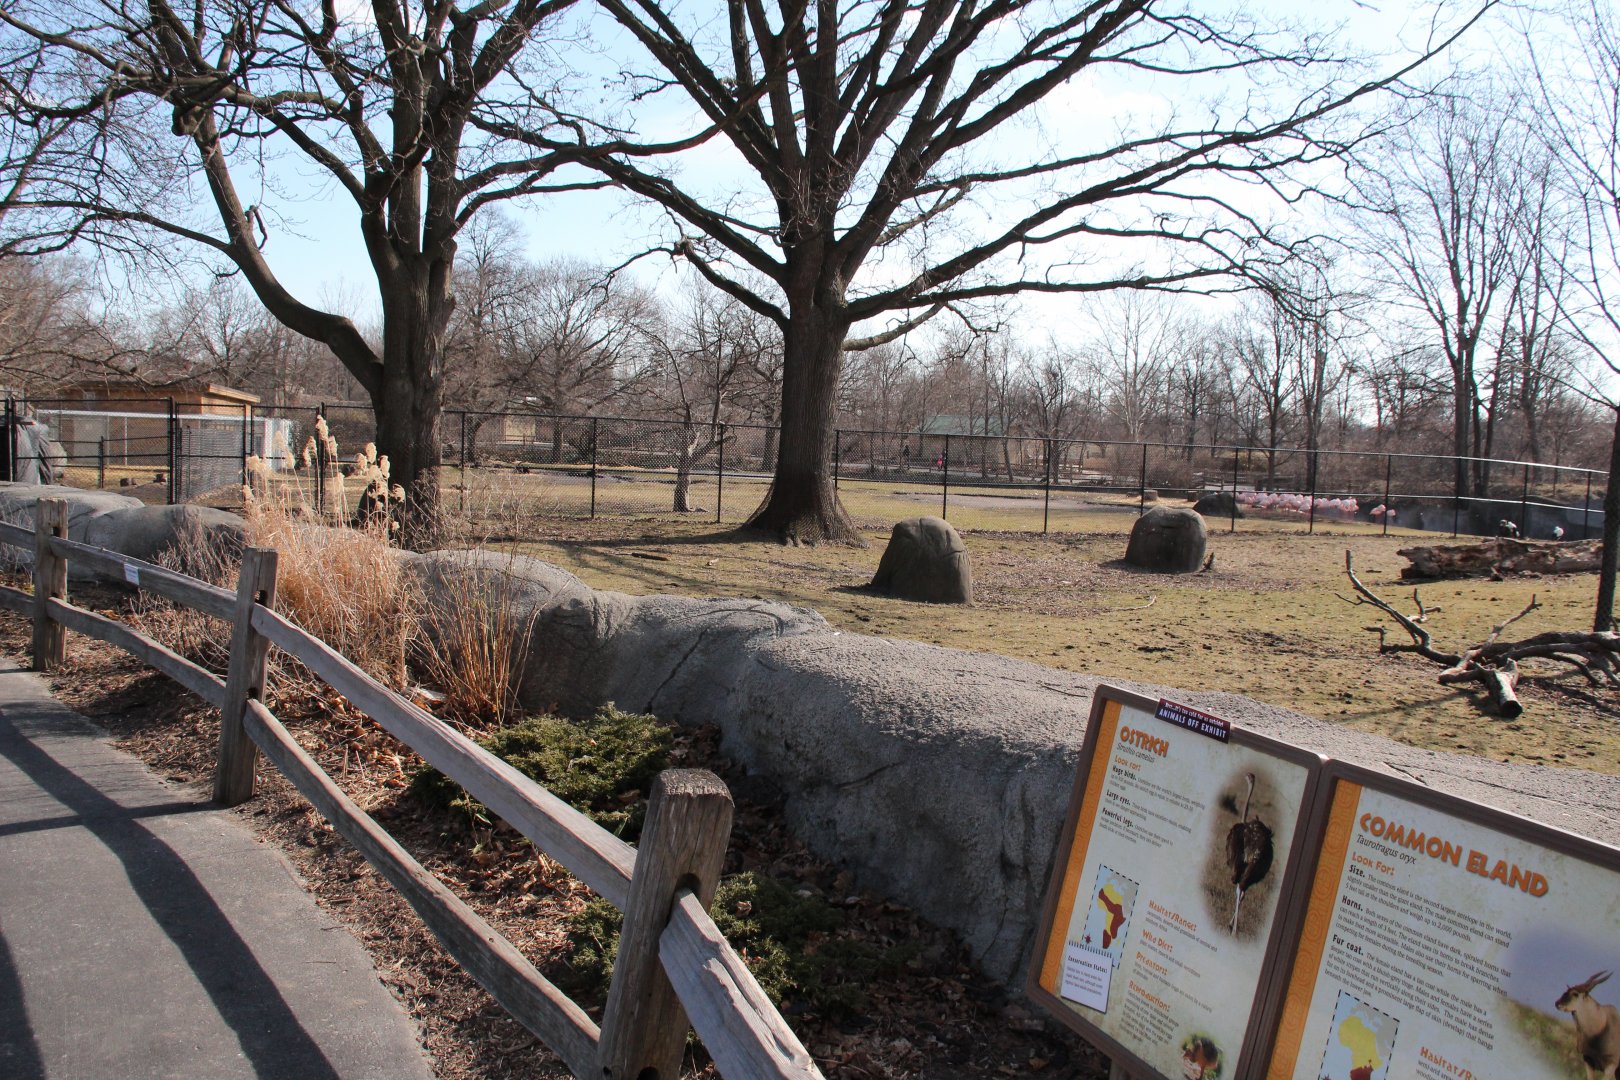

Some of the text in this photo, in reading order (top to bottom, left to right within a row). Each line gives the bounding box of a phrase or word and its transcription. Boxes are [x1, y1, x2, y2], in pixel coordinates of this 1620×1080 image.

[1158, 707, 1226, 738] ANIMALS OFF EXHIBIT
[1120, 725, 1170, 758] OSTRICH
[1111, 764, 1137, 780] Huge birds.
[1114, 754, 1128, 766] Look
[1106, 788, 1131, 806] Large eyes.
[1101, 807, 1122, 822] Powerful
[1122, 816, 1134, 829] legs.
[1351, 851, 1374, 868] Look
[1355, 833, 1417, 865] Taurotragus oryx
[1360, 812, 1549, 898] COMMON ELAND
[1348, 863, 1366, 878] Size.
[1439, 903, 1456, 916] largest
[1456, 911, 1477, 925] antelope
[1485, 922, 1494, 931] the
[1495, 927, 1512, 940] world,
[1141, 928, 1157, 944] Wild
[1341, 894, 1364, 911] Horns.
[1449, 944, 1462, 957] dark,
[1462, 952, 1483, 965] spiraled
[1483, 959, 1499, 972] horns
[1409, 910, 1423, 921] weigh
[1423, 917, 1430, 925] up
[1437, 921, 1452, 933] 2,000
[1424, 906, 1434, 916] The
[1446, 917, 1468, 931] common
[1469, 926, 1484, 937] eland
[1494, 937, 1510, 948] stand
[1067, 955, 1092, 968] Conservation
[1135, 950, 1168, 976] Predators:
[1332, 933, 1345, 946] Fur
[1345, 940, 1364, 956] coat.
[1436, 987, 1449, 998] while
[1450, 992, 1459, 1002] the
[1398, 931, 1407, 940] The
[1439, 949, 1453, 961] horns
[1460, 959, 1475, 971] break
[1475, 965, 1499, 982] branches
[1400, 941, 1414, 953] Males
[1433, 957, 1446, 968] their
[1446, 962, 1461, 975] horns
[1470, 975, 1491, 990] sparring
[1492, 984, 1508, 997] when
[1405, 953, 1426, 970] breeding
[1128, 979, 1170, 1012] Reproduction:
[1378, 978, 1400, 994] vertically
[1414, 994, 1426, 1006] their
[1443, 1008, 1453, 1020] The
[1478, 1026, 1494, 1040] dense
[1415, 984, 1429, 998] Males
[1429, 993, 1440, 1002] and
[1459, 1006, 1472, 1019] have
[1477, 1016, 1493, 1029] series
[1402, 998, 1414, 1010] large
[1431, 1014, 1441, 1024] skin
[1465, 1030, 1476, 1041] that
[1476, 1035, 1493, 1050] hangs
[1420, 1046, 1479, 1080] Habitat/R
